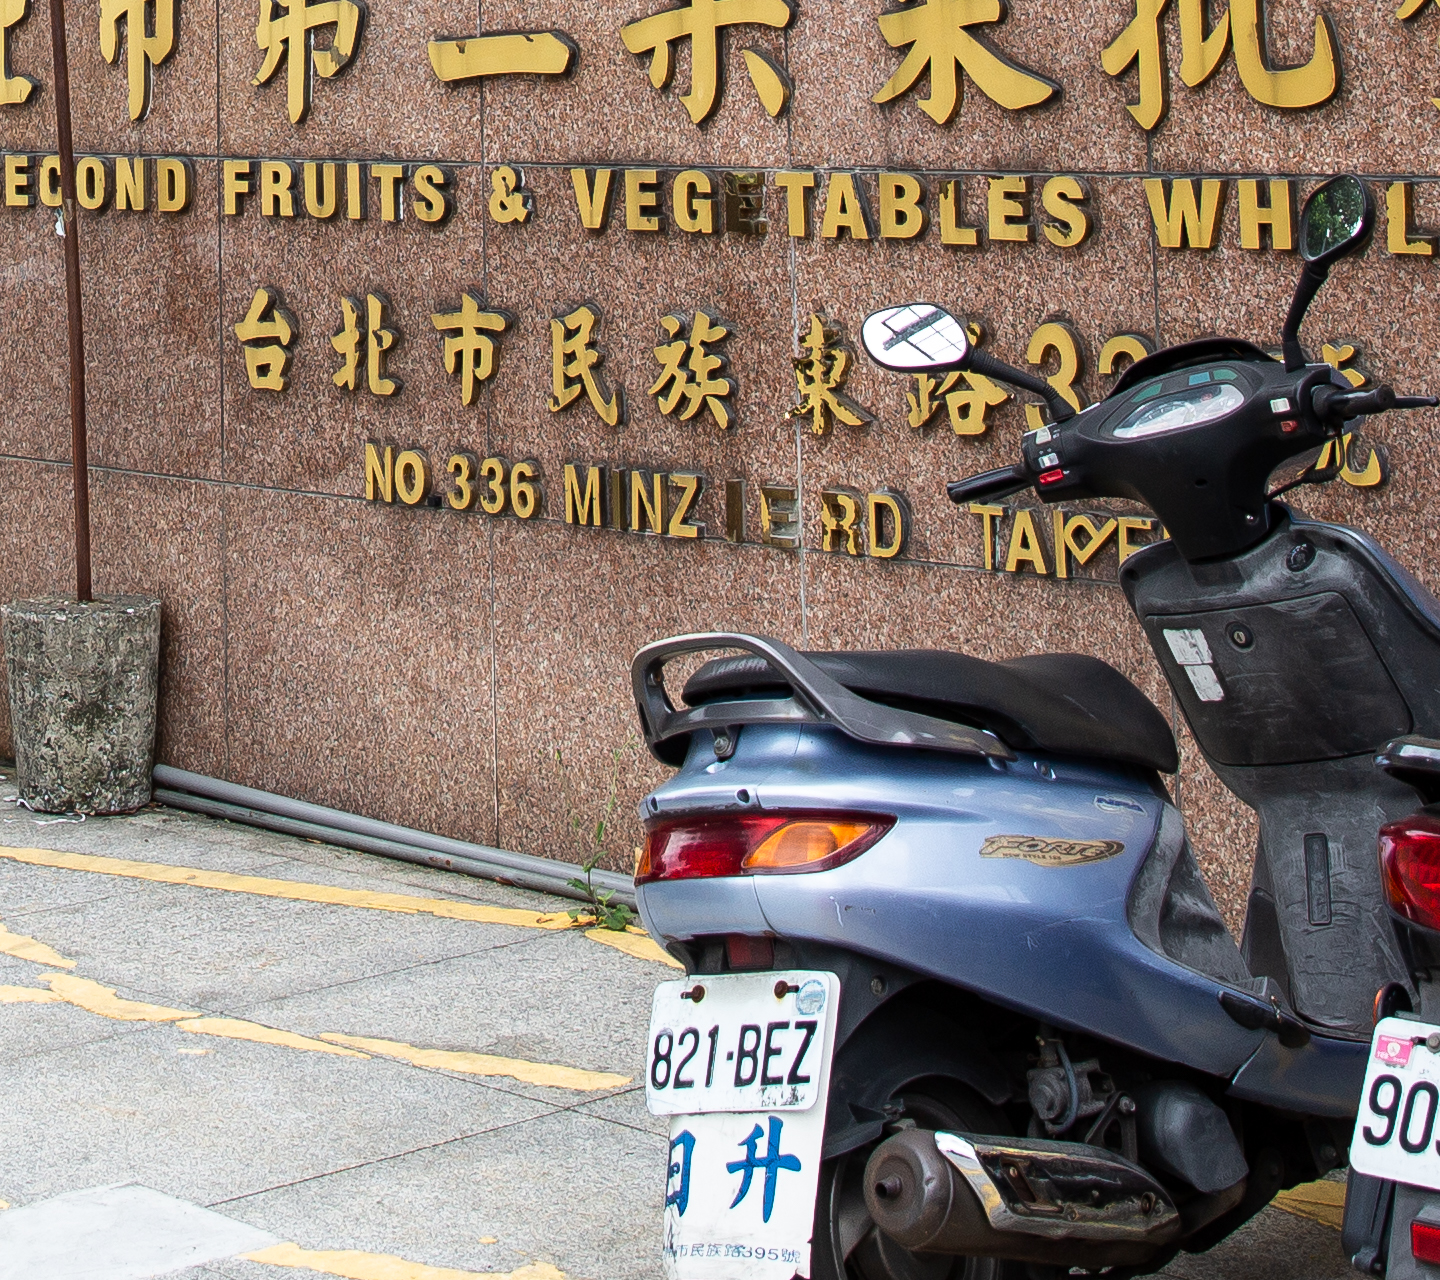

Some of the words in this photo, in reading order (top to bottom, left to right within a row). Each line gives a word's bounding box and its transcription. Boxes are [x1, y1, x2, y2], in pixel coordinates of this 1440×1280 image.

[223, 161, 450, 224] FRUITS
[489, 165, 531, 224] &
[570, 167, 1094, 248] VEGETABLES
[969, 504, 1171, 579] TAIPE
[650, 1019, 818, 1092] 821-BEZ
